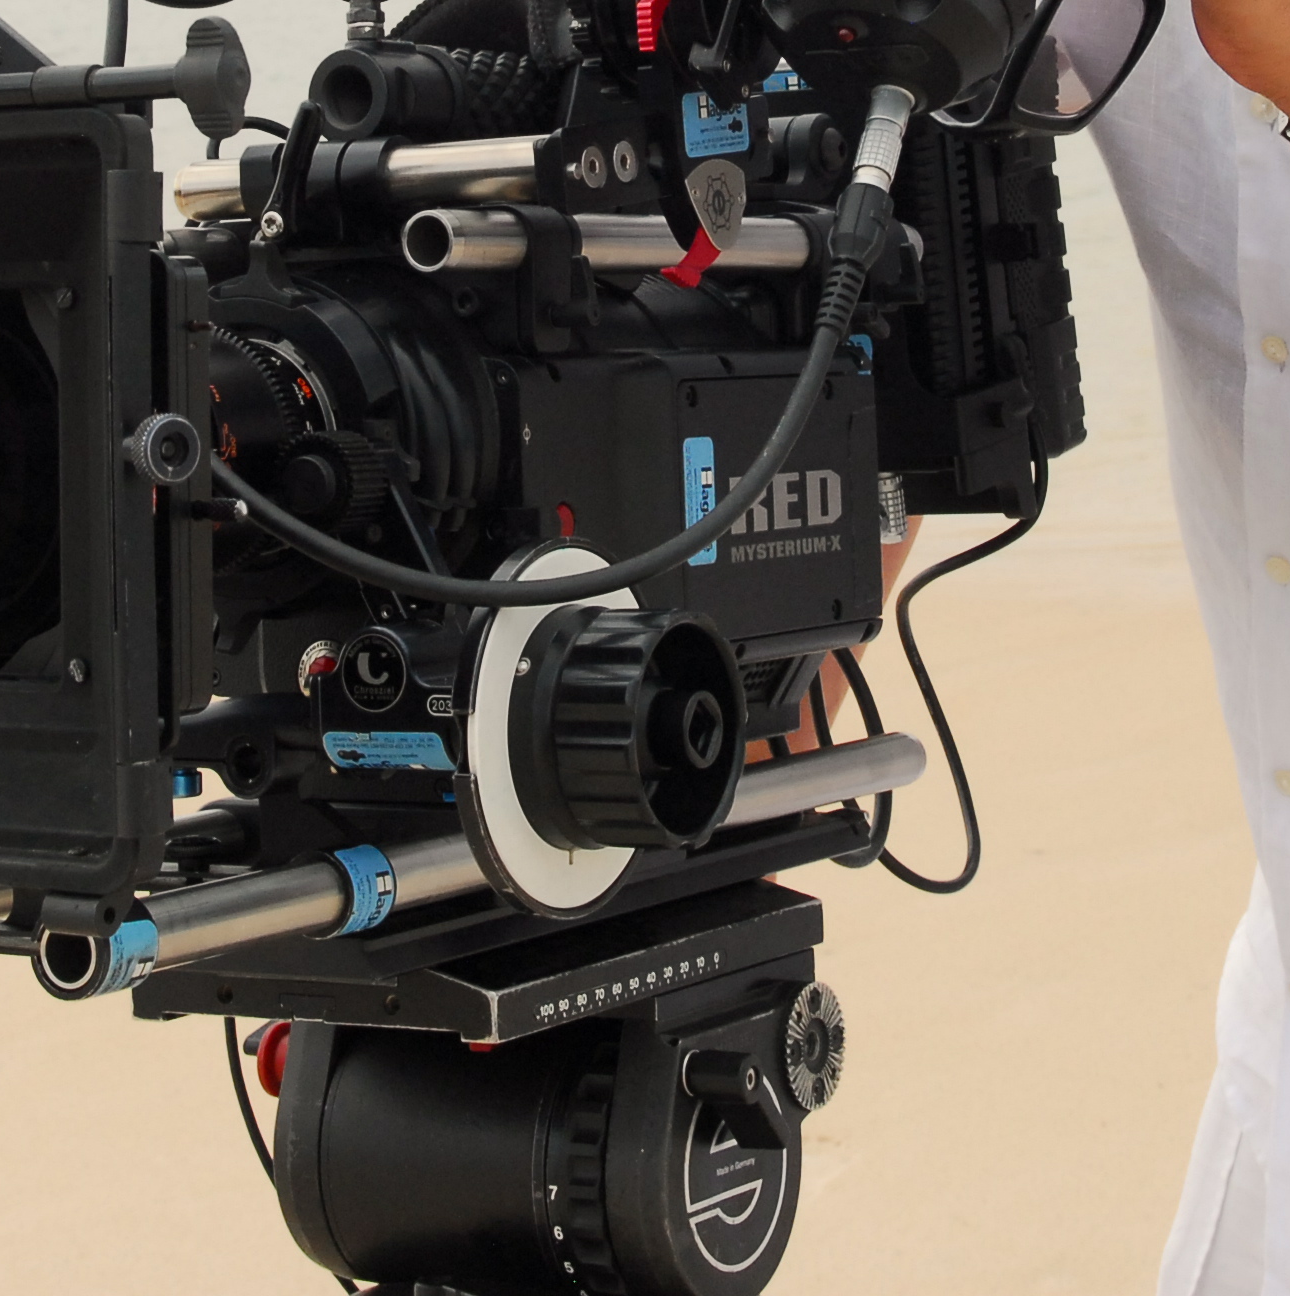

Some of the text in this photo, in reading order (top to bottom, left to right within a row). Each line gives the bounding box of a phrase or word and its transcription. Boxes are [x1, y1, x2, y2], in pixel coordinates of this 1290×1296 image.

[539, 952, 720, 1017] 100 90 80 70 60 50 40 30 20 10 0
[548, 1184, 558, 1201] 7
[553, 1225, 564, 1240] 6
[563, 1261, 574, 1274] 5
